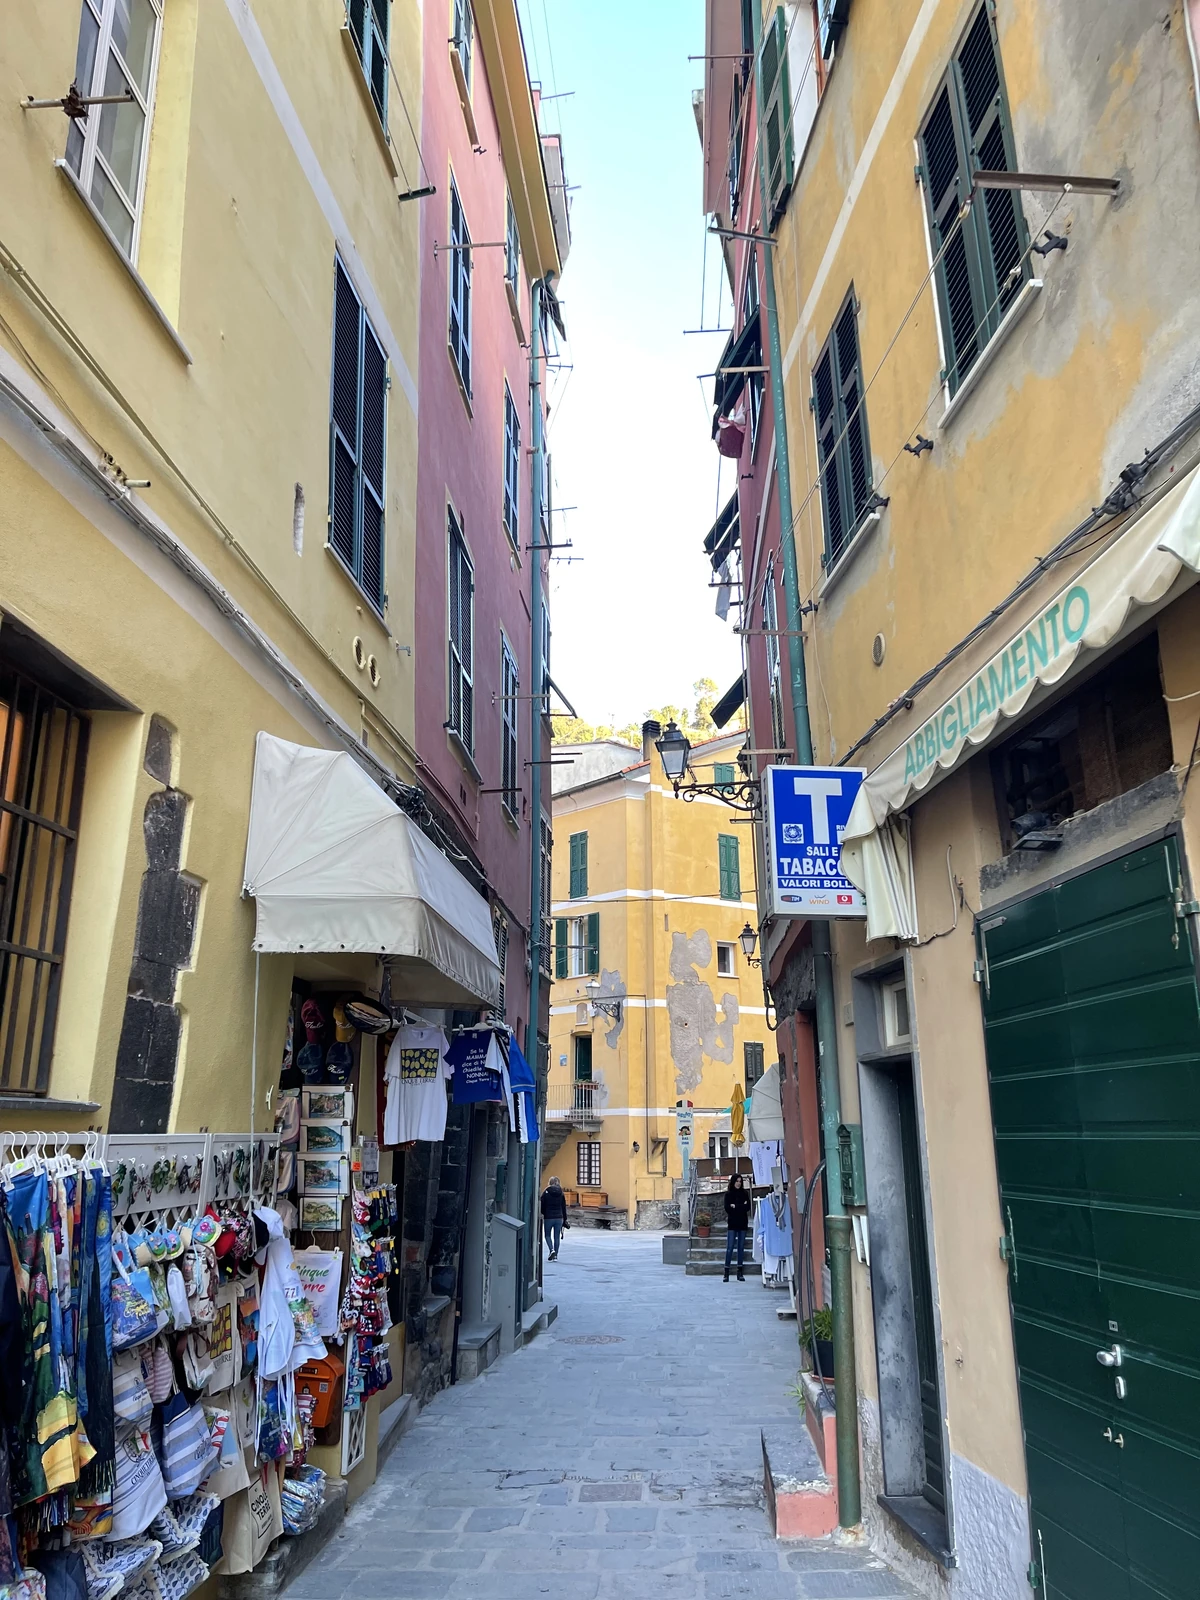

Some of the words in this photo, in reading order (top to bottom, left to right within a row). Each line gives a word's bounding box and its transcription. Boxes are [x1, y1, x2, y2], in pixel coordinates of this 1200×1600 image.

[903, 585, 1091, 785] ABBIGLIAMENTO
[793, 777, 843, 845] T
[806, 846, 829, 857] SALI
[831, 846, 839, 857] E
[781, 879, 821, 888] VALORI
[823, 880, 854, 888] BOLL
